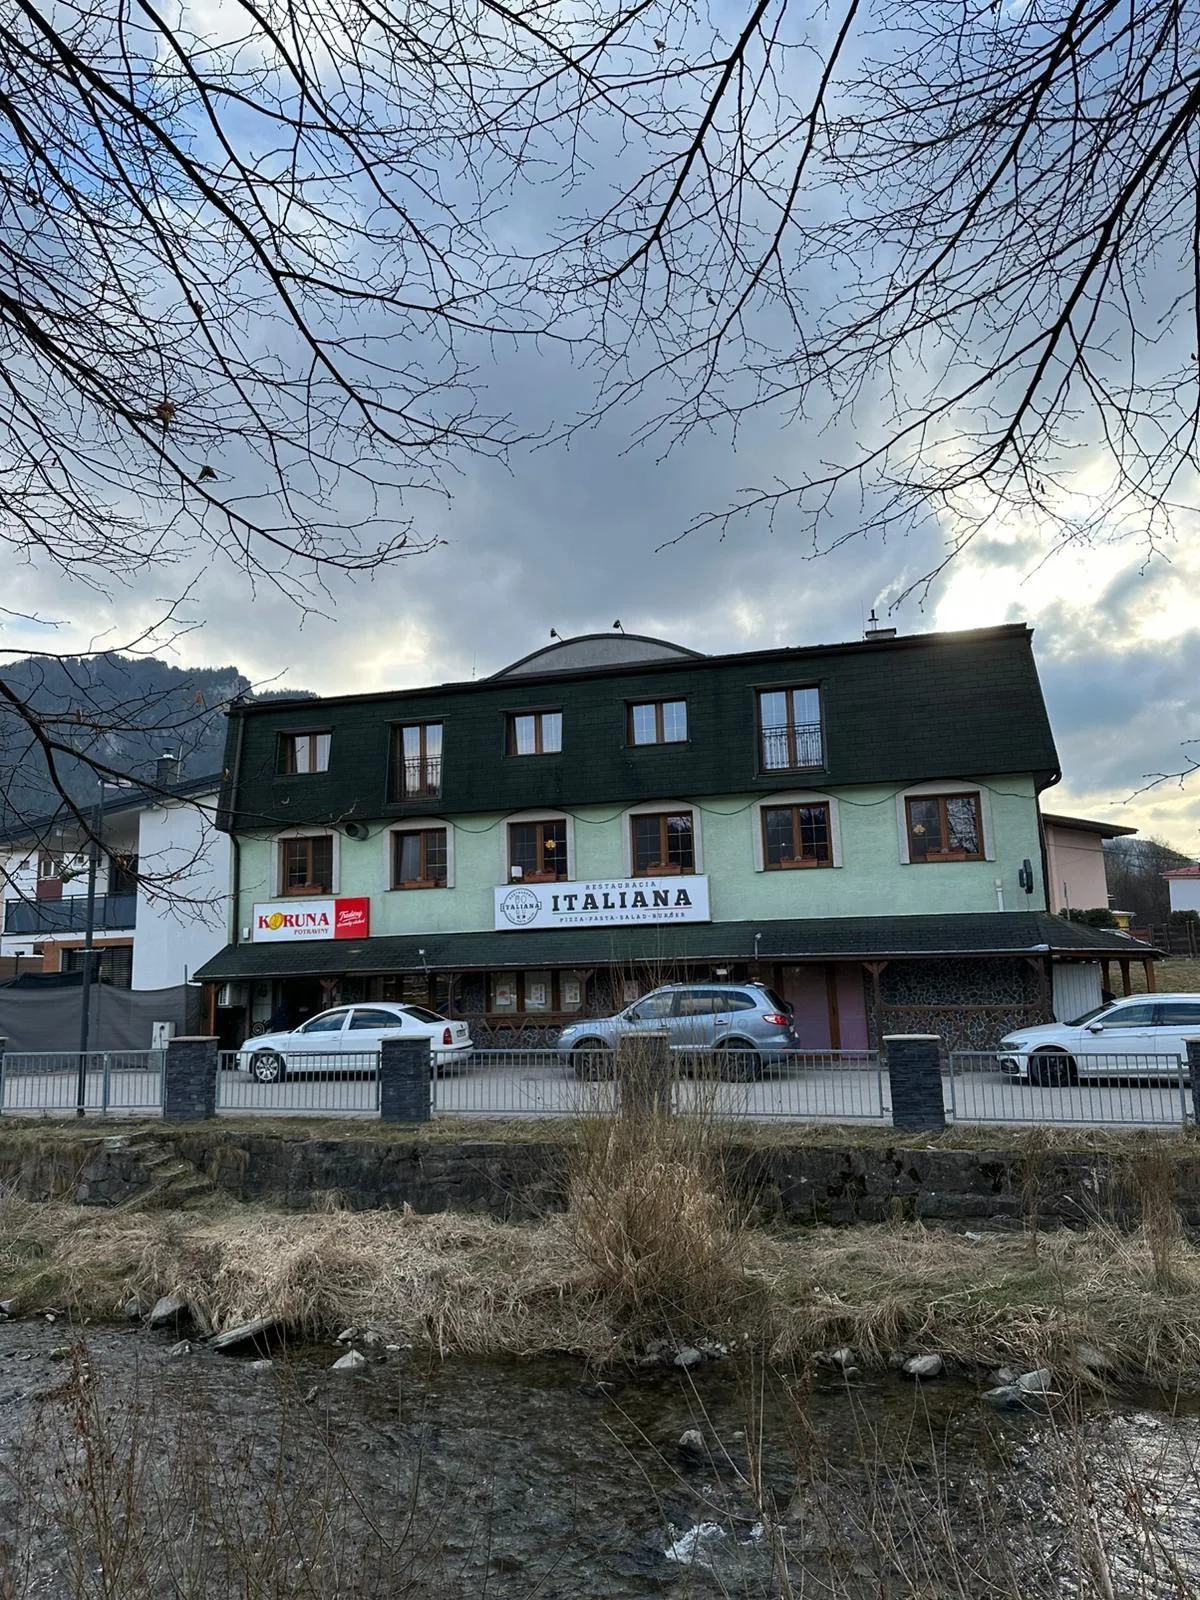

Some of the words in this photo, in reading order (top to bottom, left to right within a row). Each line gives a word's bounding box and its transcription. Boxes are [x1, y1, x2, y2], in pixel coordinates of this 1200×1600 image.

[552, 889, 692, 911] ITALIANA
[501, 903, 540, 911] ITALIANA
[258, 913, 329, 930] KORUNA
[294, 928, 329, 936] POTRAVINY
